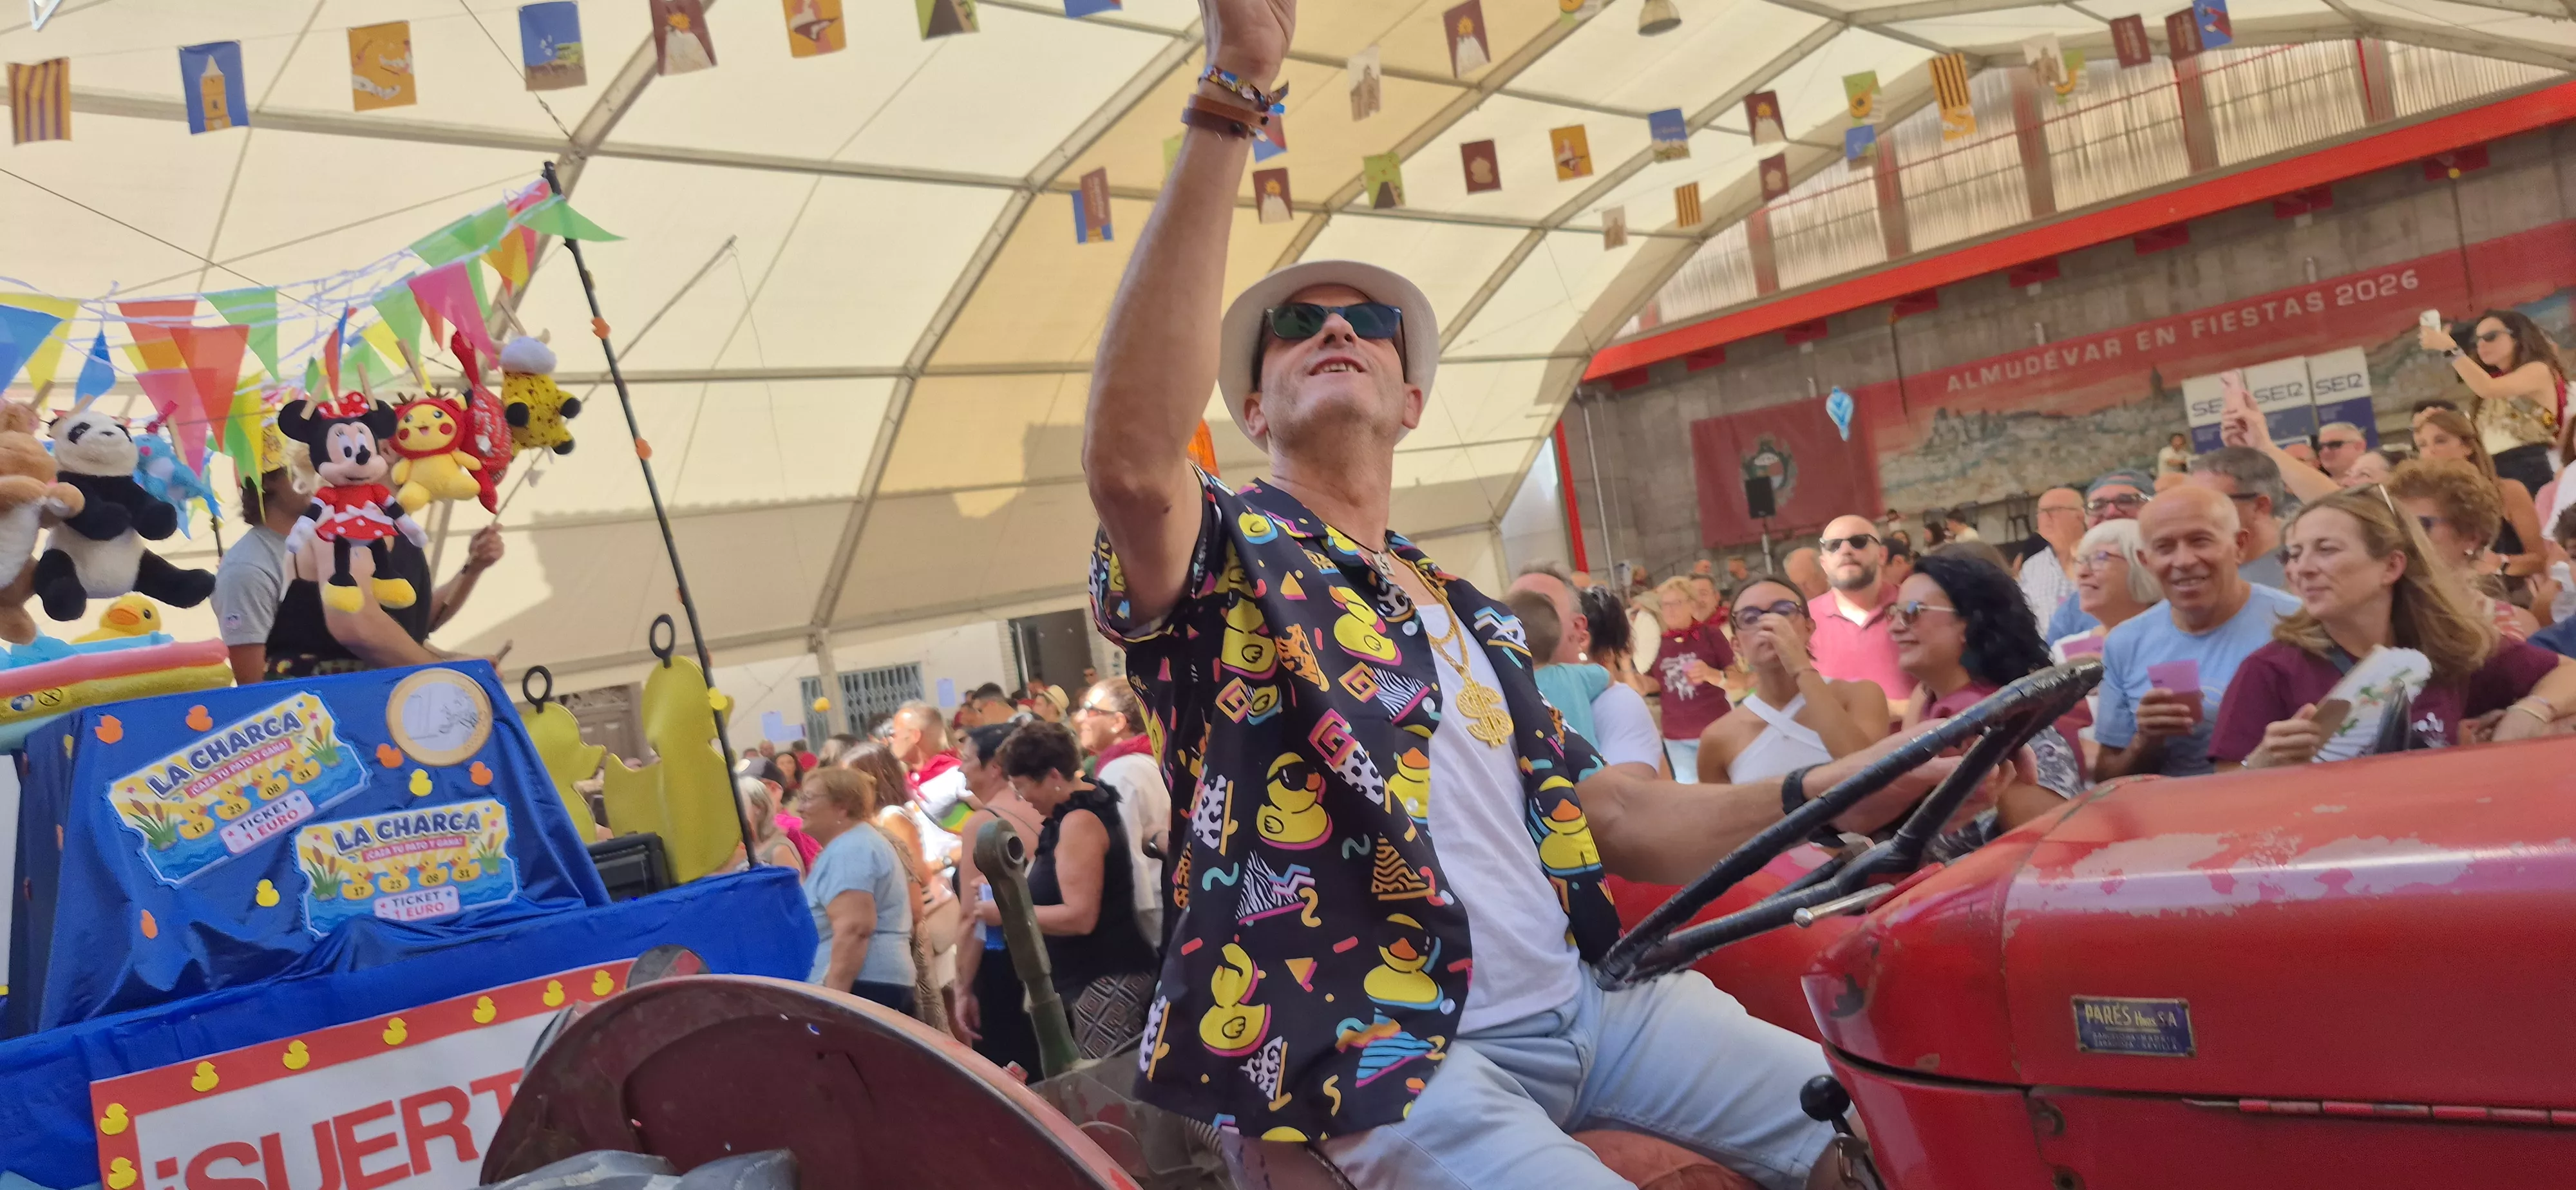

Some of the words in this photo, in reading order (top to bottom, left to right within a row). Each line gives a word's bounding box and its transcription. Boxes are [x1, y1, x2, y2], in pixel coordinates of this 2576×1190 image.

[2136, 325, 2176, 352] EN
[2191, 290, 2325, 339] FIESTAS
[2335, 269, 2419, 306] 2026
[2254, 382, 2304, 404] SER
[2315, 373, 2364, 395] SER
[2192, 397, 2224, 417] SE
[148, 764, 189, 796] LA
[191, 712, 301, 770] CHARCA
[216, 767, 230, 780] TU
[229, 757, 254, 773] PATO
[252, 751, 261, 760] Y
[193, 822, 205, 835] 17
[227, 803, 244, 817] 23
[265, 782, 282, 797] 08
[297, 769, 312, 782] 31
[237, 799, 289, 831] TICKET
[245, 832, 254, 843] 1
[257, 809, 300, 836] EURO
[333, 827, 371, 852] LA
[376, 811, 481, 840] CHARCA
[392, 845, 405, 855] TU
[404, 840, 429, 852] PATO
[429, 839, 436, 848] Y
[353, 886, 365, 897] 17
[388, 879, 402, 890] 23
[425, 873, 439, 884] 08
[458, 869, 471, 879] 31
[391, 891, 441, 908] TICKET
[393, 910, 401, 920] 1
[406, 902, 444, 918] EURO
